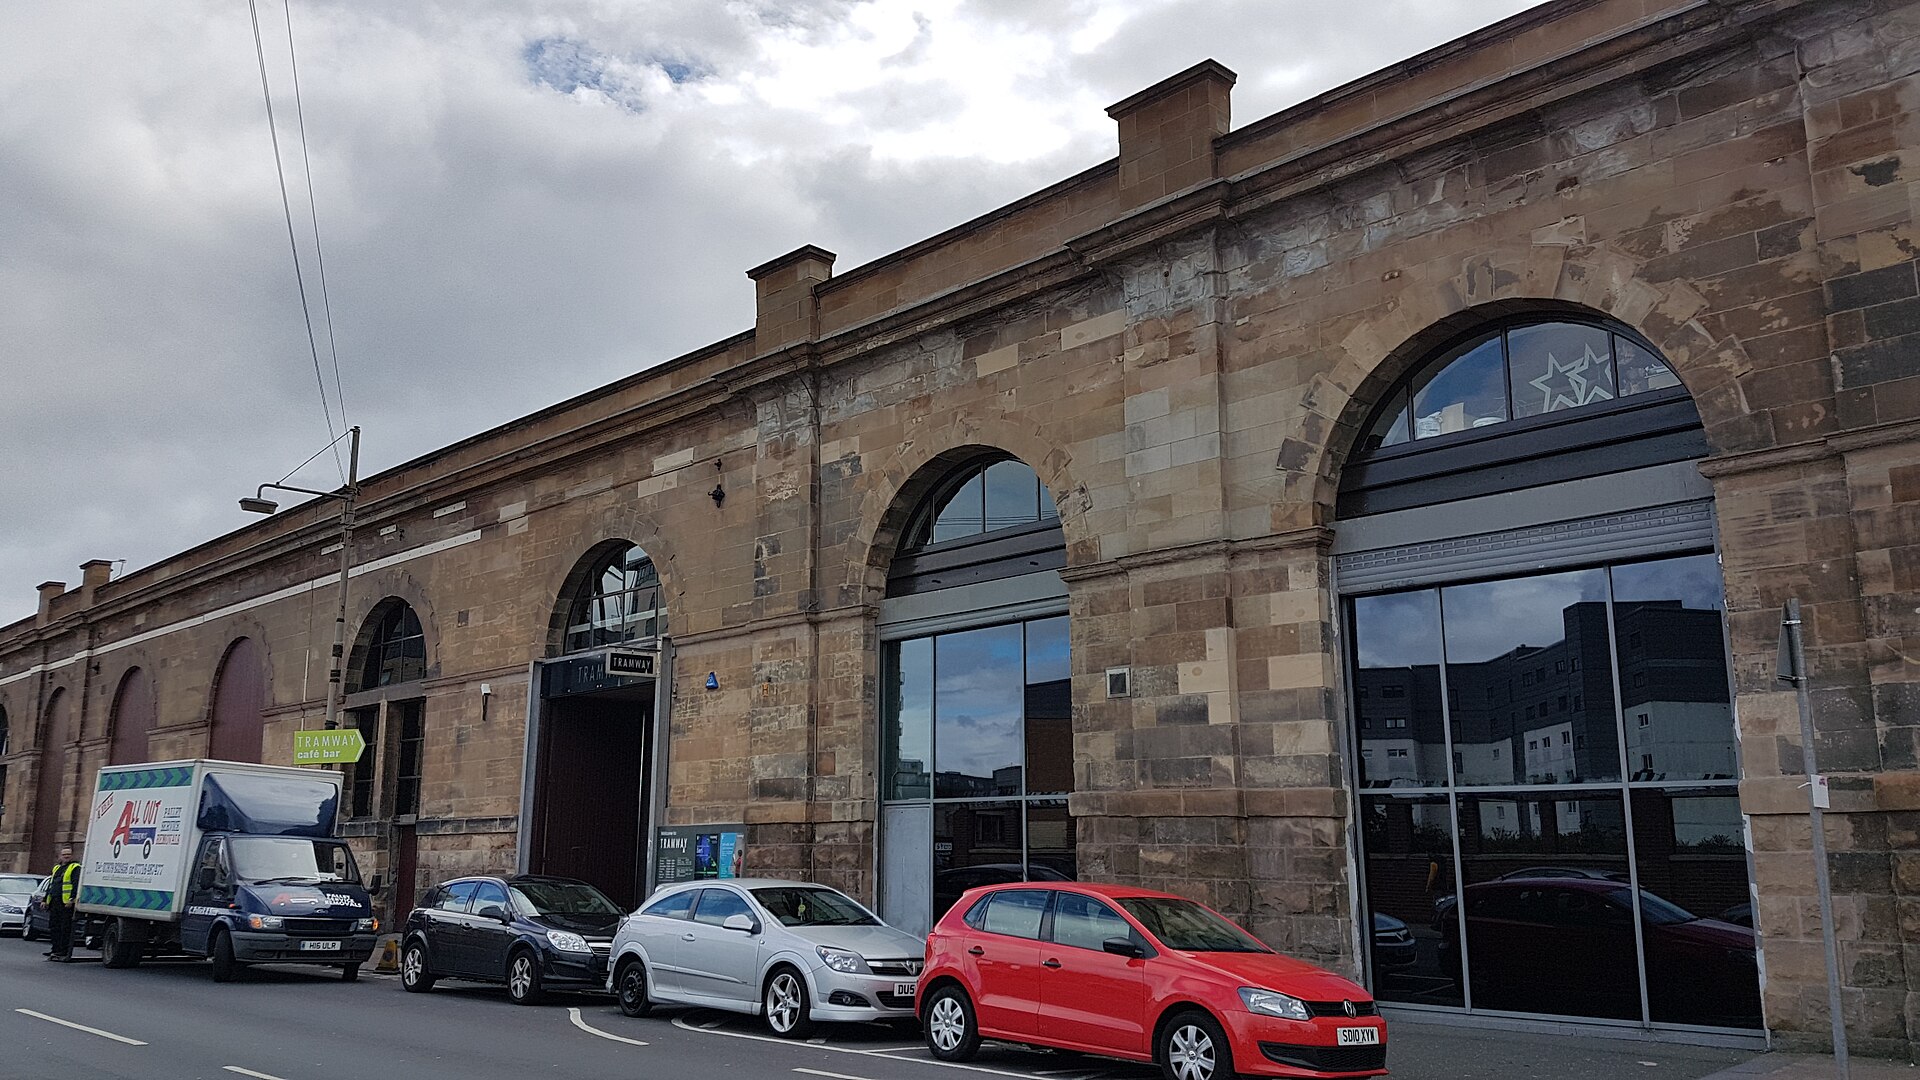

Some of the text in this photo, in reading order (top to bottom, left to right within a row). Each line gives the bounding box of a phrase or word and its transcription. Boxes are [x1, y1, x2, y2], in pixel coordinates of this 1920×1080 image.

[613, 657, 651, 675] TRAMWAY
[297, 734, 356, 748] TRAMWAY
[297, 750, 340, 759] café bar
[660, 838, 688, 853] TRAMWAY
[1342, 1029, 1360, 1043] SD10
